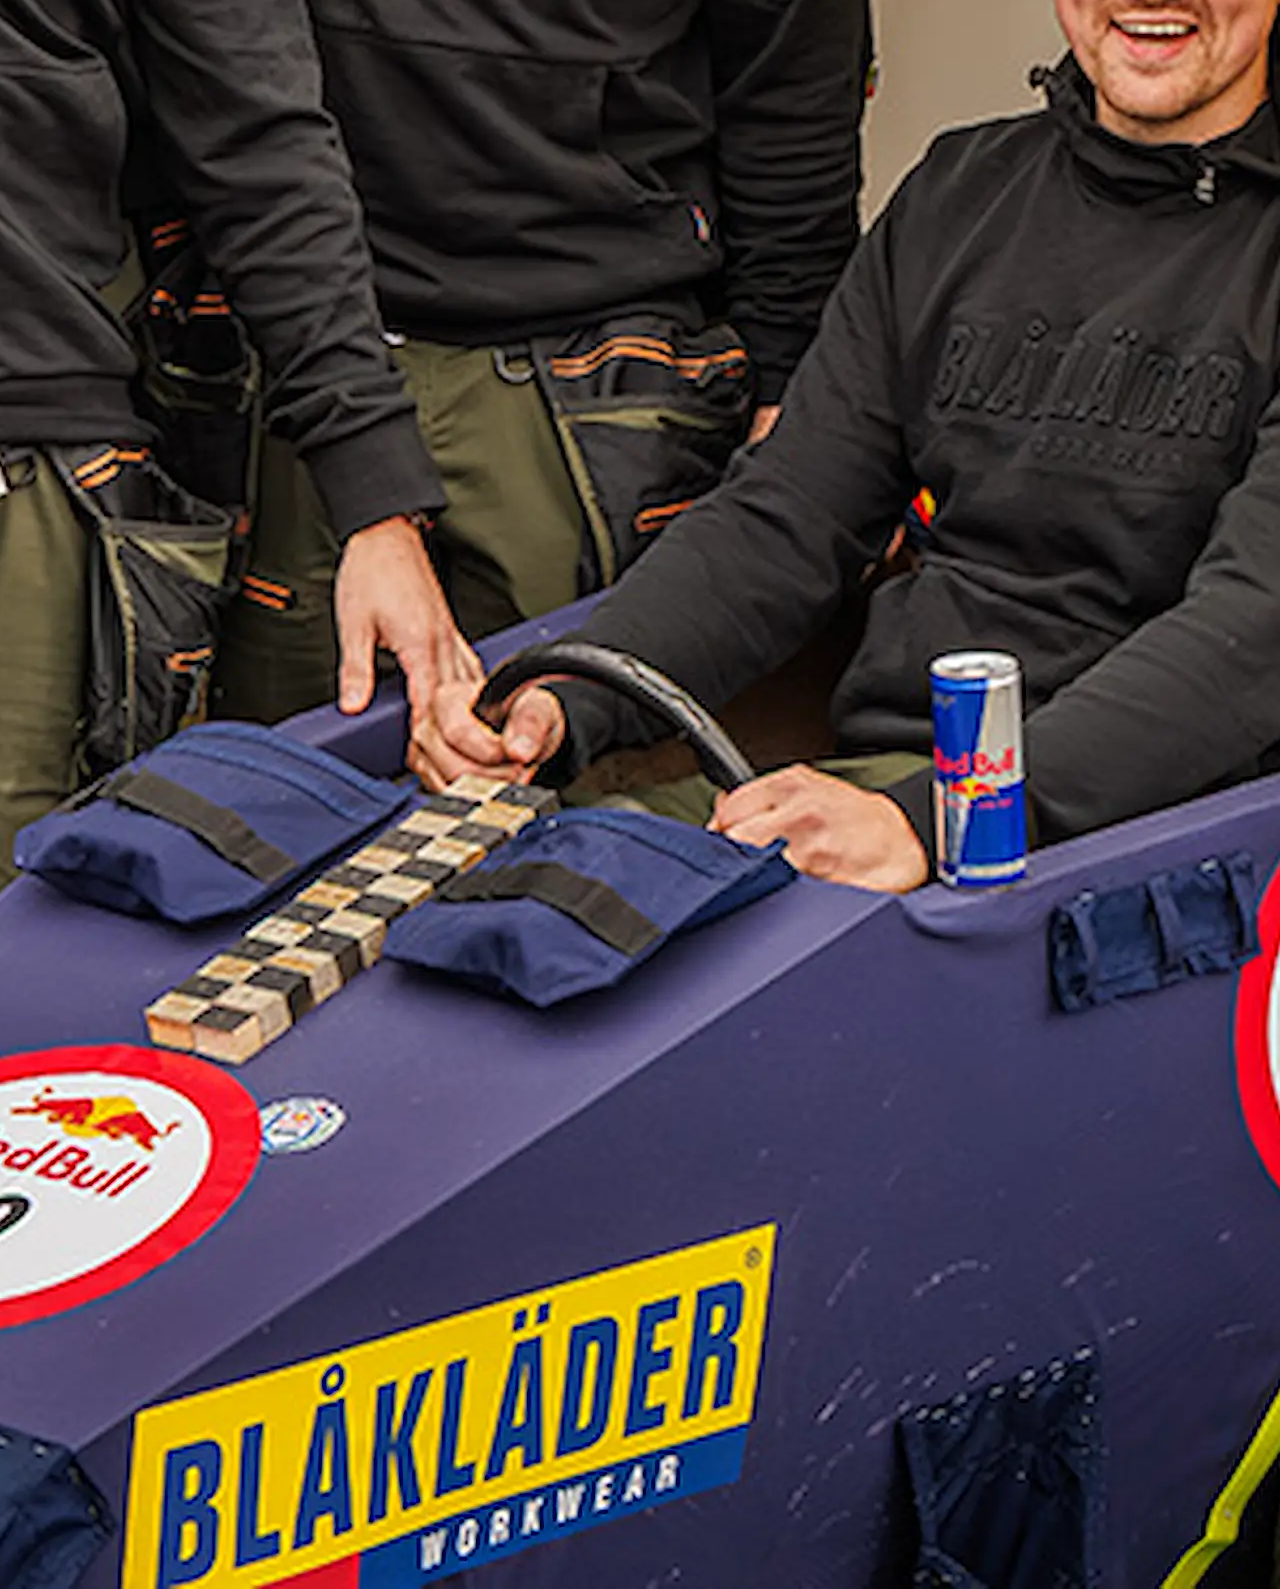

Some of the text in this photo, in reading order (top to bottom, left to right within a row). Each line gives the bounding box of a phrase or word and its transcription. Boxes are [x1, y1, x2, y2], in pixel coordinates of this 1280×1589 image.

[36, 1140, 150, 1199] Bull
[156, 1279, 746, 1589] BLÅKLÄDER
[419, 1455, 681, 1572] WORKWEAR
